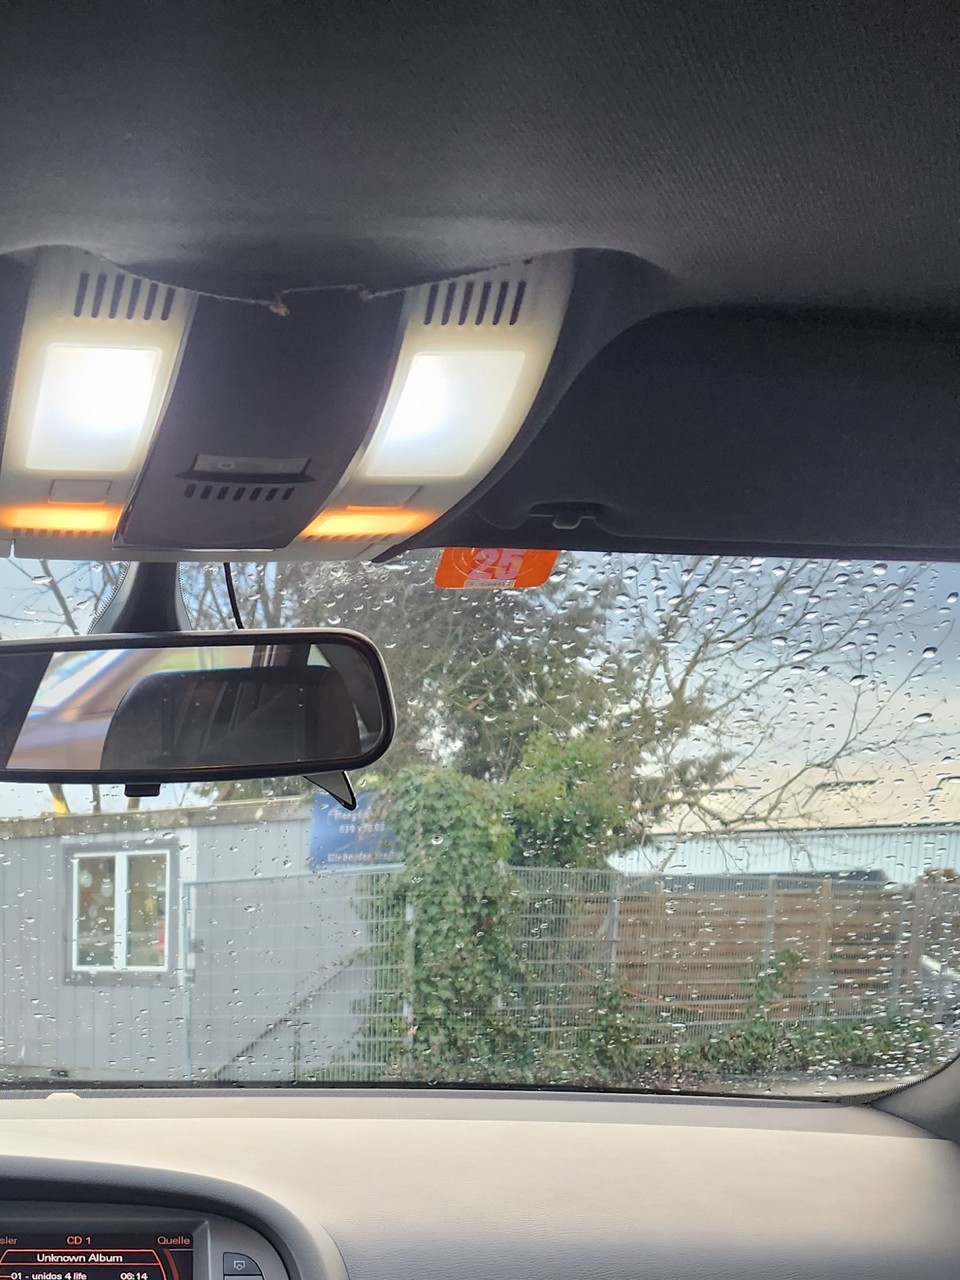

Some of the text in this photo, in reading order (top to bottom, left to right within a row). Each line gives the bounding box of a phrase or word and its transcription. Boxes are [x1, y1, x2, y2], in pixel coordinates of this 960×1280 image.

[66, 1236, 83, 1245] CD
[157, 1236, 190, 1245] Quelle
[36, 1253, 123, 1263] Unknown Album
[10, 1272, 22, 1280] 01
[31, 1272, 62, 1280] unidos
[64, 1272, 72, 1280] 4
[73, 1272, 87, 1280] life
[120, 1272, 148, 1280] 06:14
